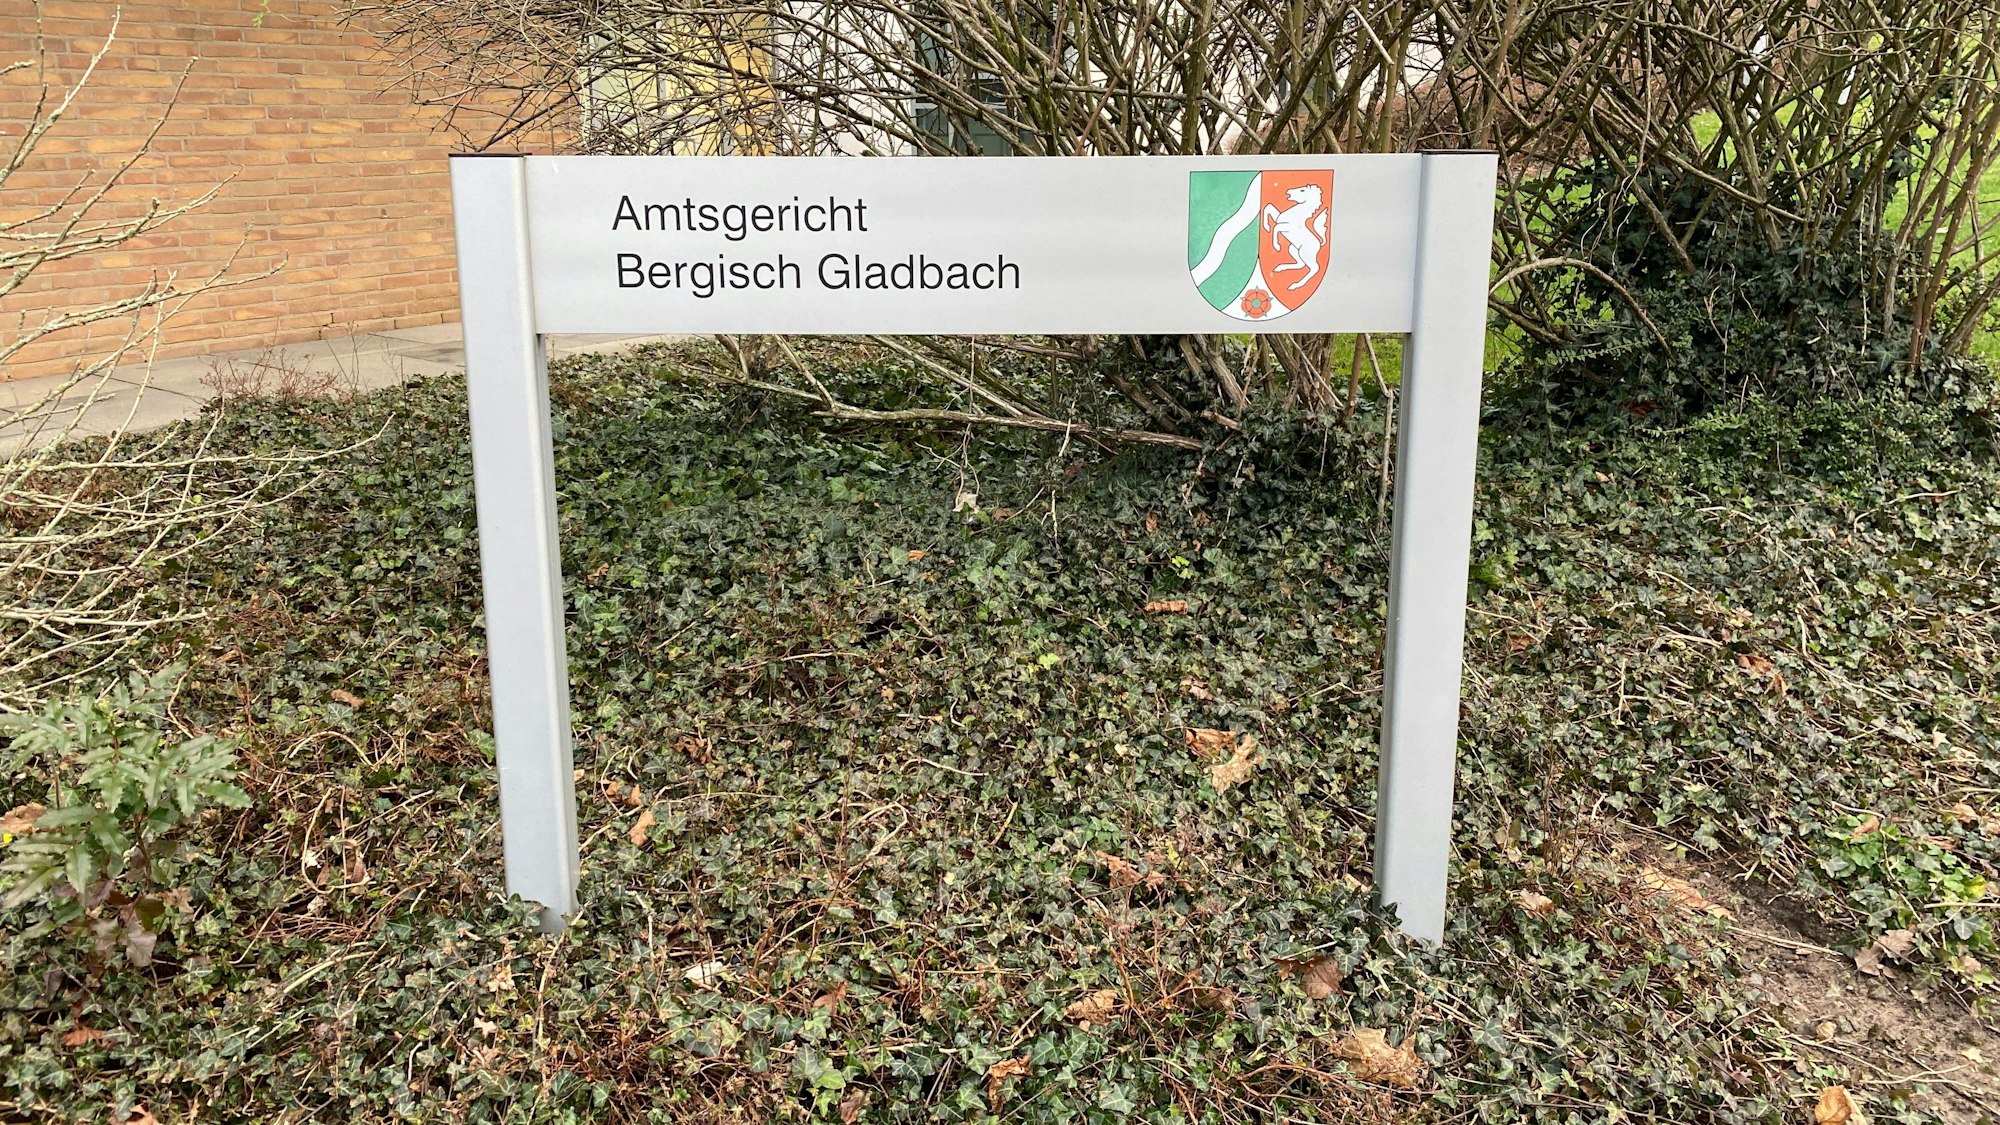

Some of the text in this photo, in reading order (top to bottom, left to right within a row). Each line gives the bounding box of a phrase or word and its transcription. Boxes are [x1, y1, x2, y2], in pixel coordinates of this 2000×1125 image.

[612, 195, 868, 241] Amtsgericht
[617, 253, 1020, 298] Bergisch Gladbach
